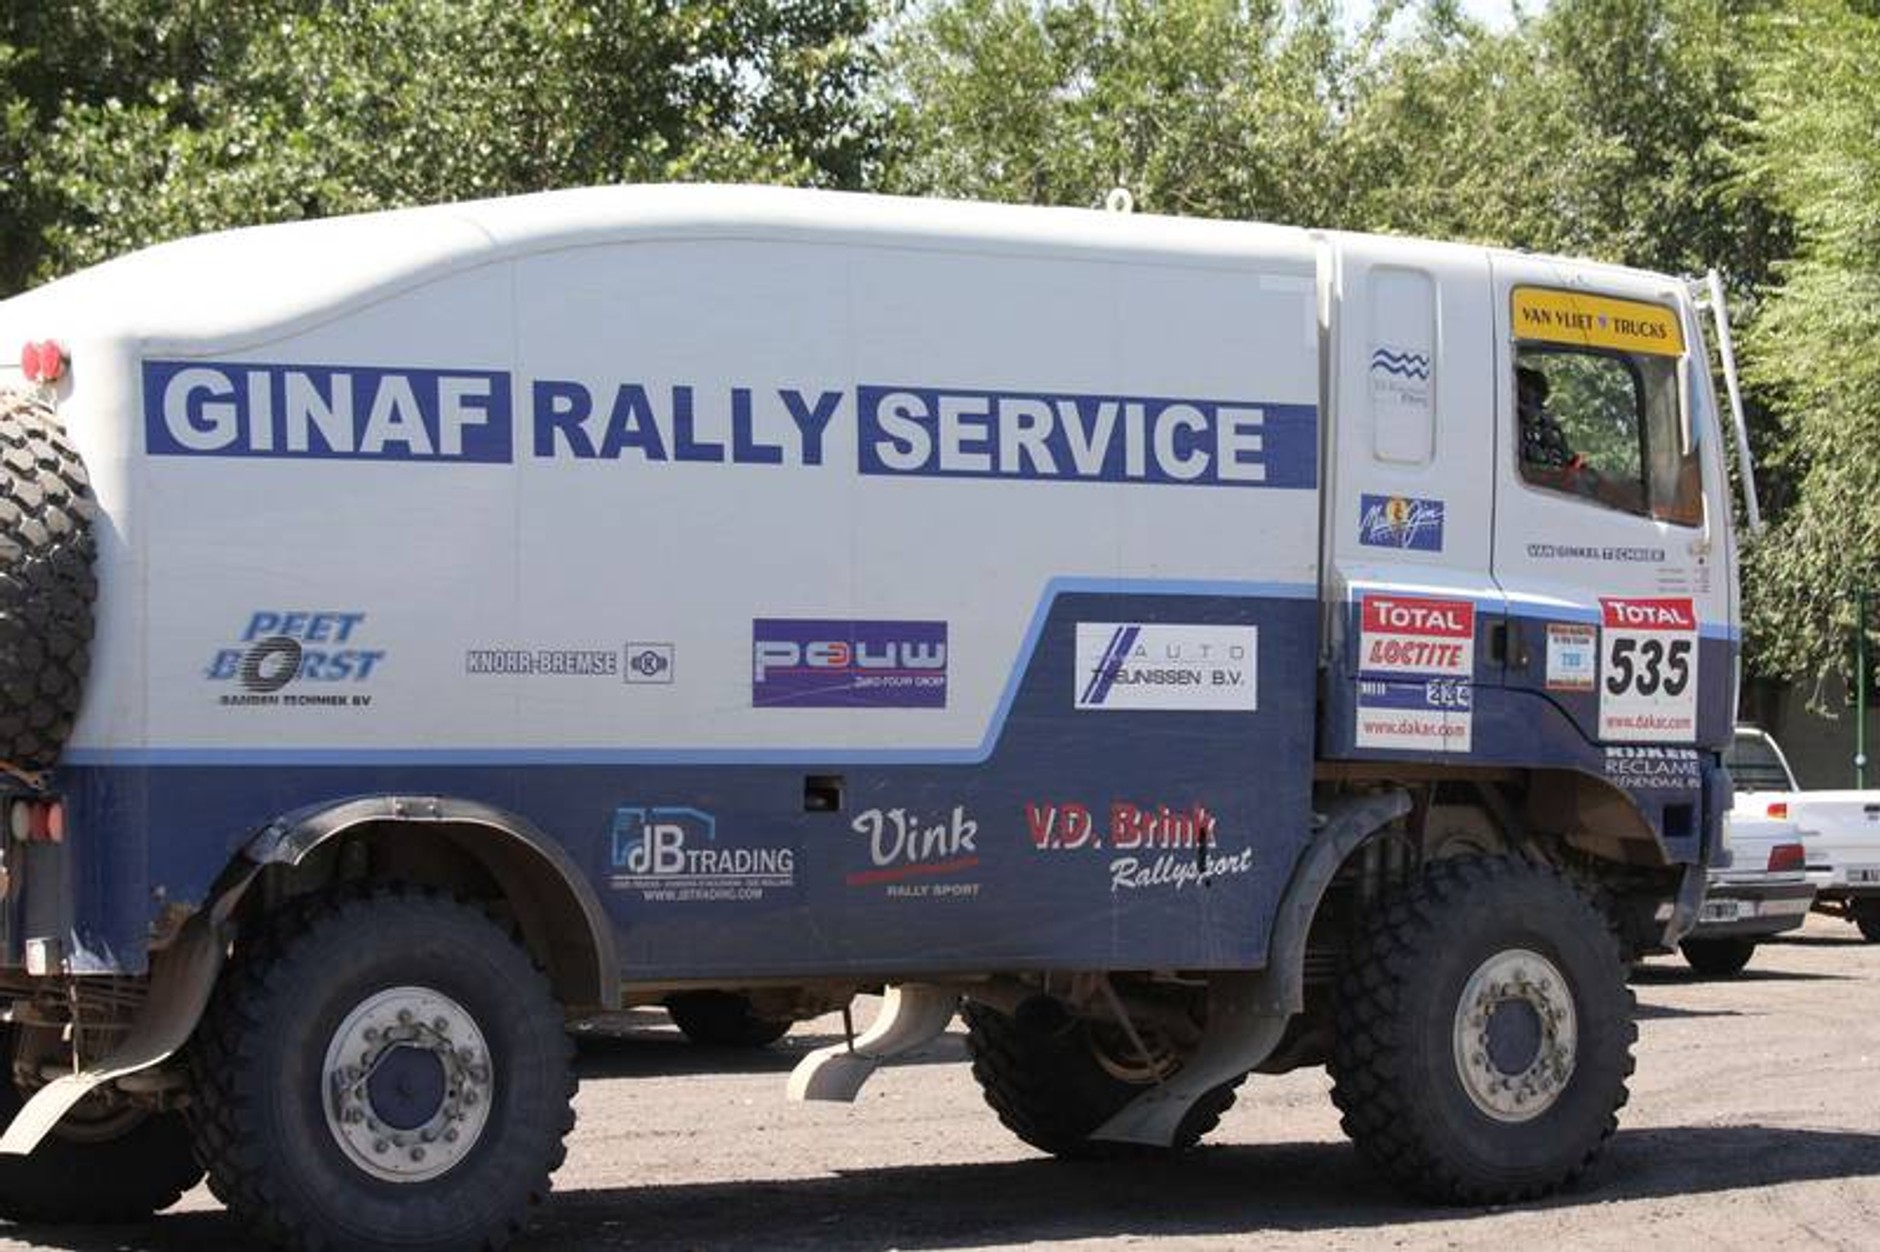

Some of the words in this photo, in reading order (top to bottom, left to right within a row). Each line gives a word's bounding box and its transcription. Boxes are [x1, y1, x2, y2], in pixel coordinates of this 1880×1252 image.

[1522, 307, 1550, 324] VAN
[1556, 311, 1593, 330] VLIET
[1614, 317, 1668, 339] TRUCKS
[163, 368, 491, 456] GINAF
[532, 380, 843, 466] RALLY
[875, 393, 1267, 482] SERVICE
[241, 611, 366, 641] PEET
[1372, 601, 1464, 630] TOTAL
[1608, 601, 1689, 624] TOTAL
[203, 636, 387, 693] BORST
[467, 650, 618, 675] KNORR-BREMSE
[1134, 643, 1245, 660] AUTO
[1369, 640, 1463, 668] LOCTITE
[1091, 668, 1202, 685] TEUNISSEN
[1212, 669, 1245, 686] B.V.
[1606, 638, 1692, 696] 535
[1364, 719, 1466, 738] www.dakar.com
[1606, 714, 1692, 730] www.dakar.com
[1604, 758, 1700, 775] RECLAME
[852, 805, 978, 866] Vink
[1025, 802, 1101, 850] V.D.
[1110, 801, 1217, 850] Brink
[686, 849, 794, 874] TRADING
[1109, 846, 1252, 893] Rallysport
[886, 884, 928, 897] RALLY
[933, 883, 980, 896] SPORT
